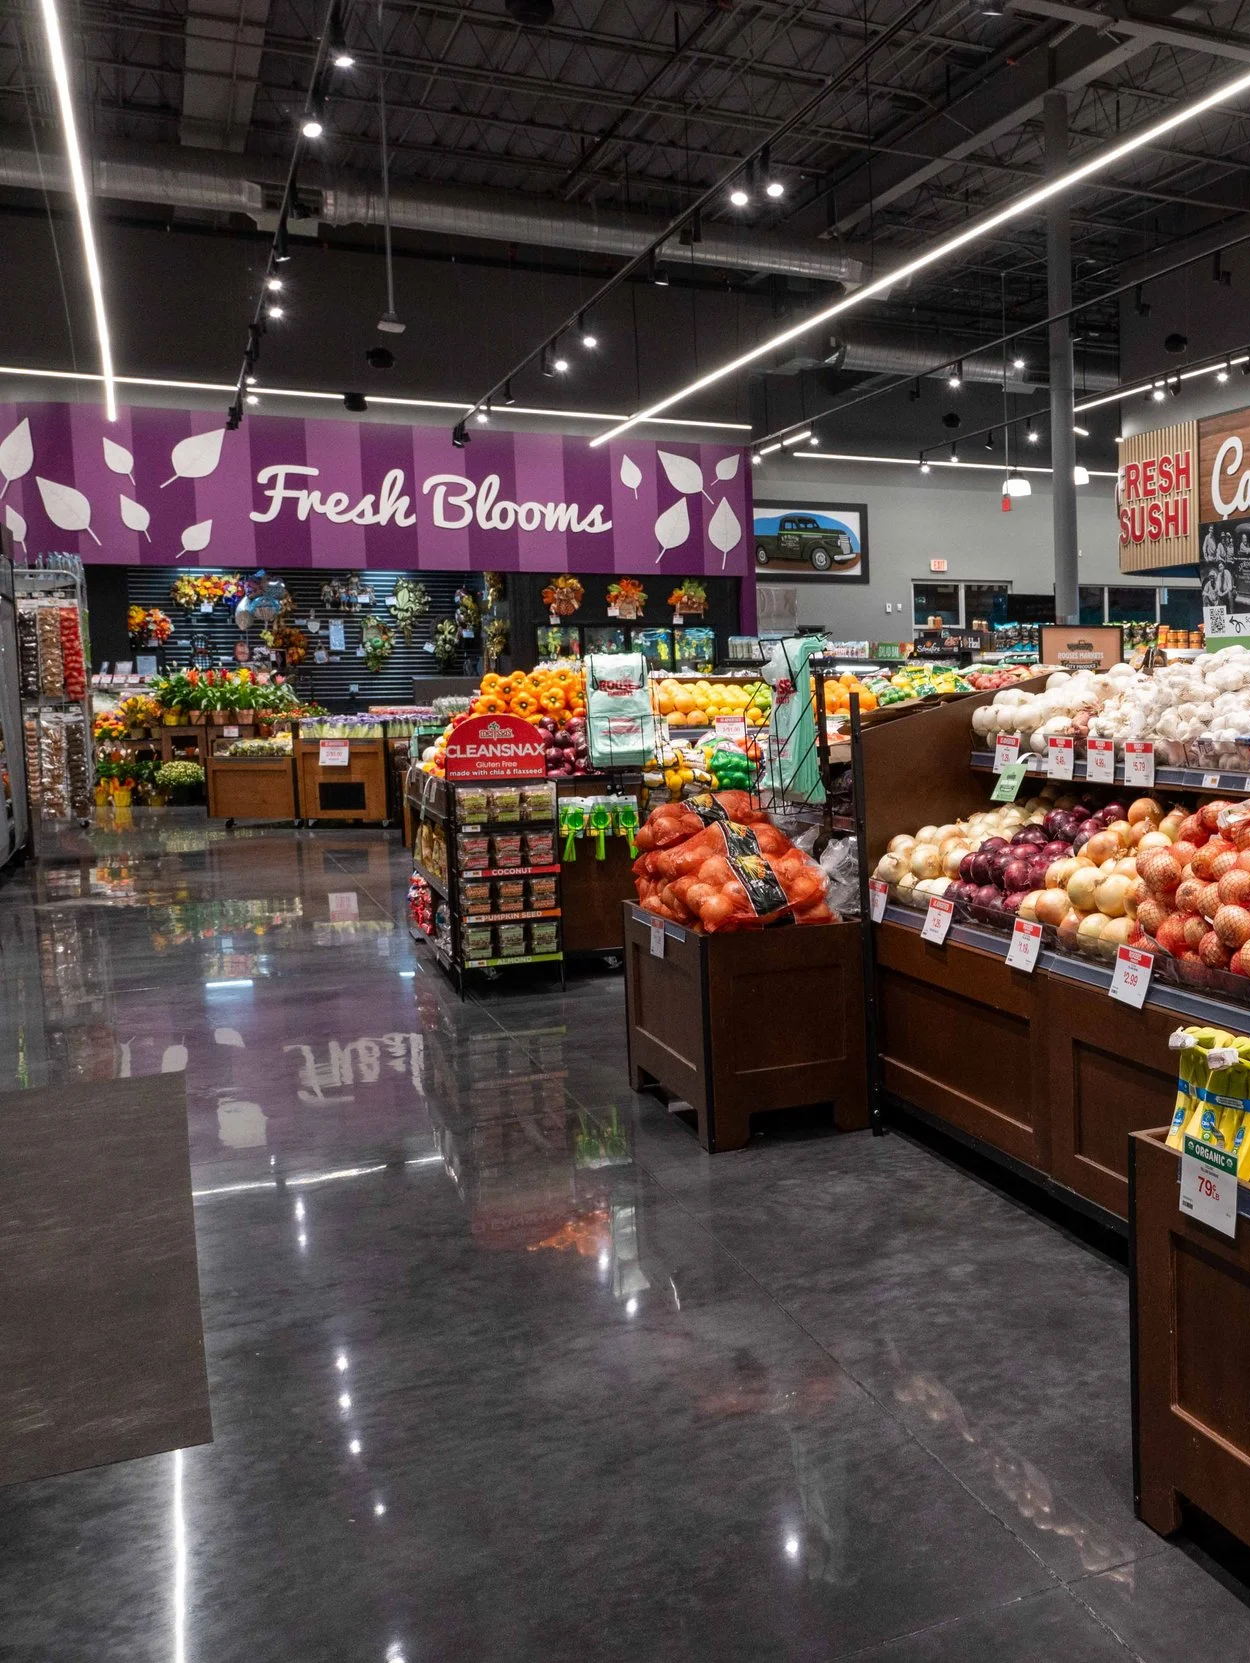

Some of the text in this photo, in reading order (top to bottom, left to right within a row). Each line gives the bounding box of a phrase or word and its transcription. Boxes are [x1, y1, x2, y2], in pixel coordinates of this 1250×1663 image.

[249, 464, 612, 533] Fresh Blooms
[1119, 495, 1189, 546] SUSHI
[933, 560, 945, 570] EXIT
[446, 743, 546, 758] CLEANSNAX
[501, 760, 518, 768] Free
[449, 769, 470, 777] made
[472, 769, 488, 777] with
[489, 768, 504, 776] chia
[513, 767, 543, 775] flaxseed
[491, 867, 532, 876] COCONUT
[484, 911, 543, 921] PUMPKIN SEED
[496, 956, 532, 965] ALMOND
[1123, 970, 1139, 987] $2.99
[1195, 1143, 1225, 1168] ORGANIC
